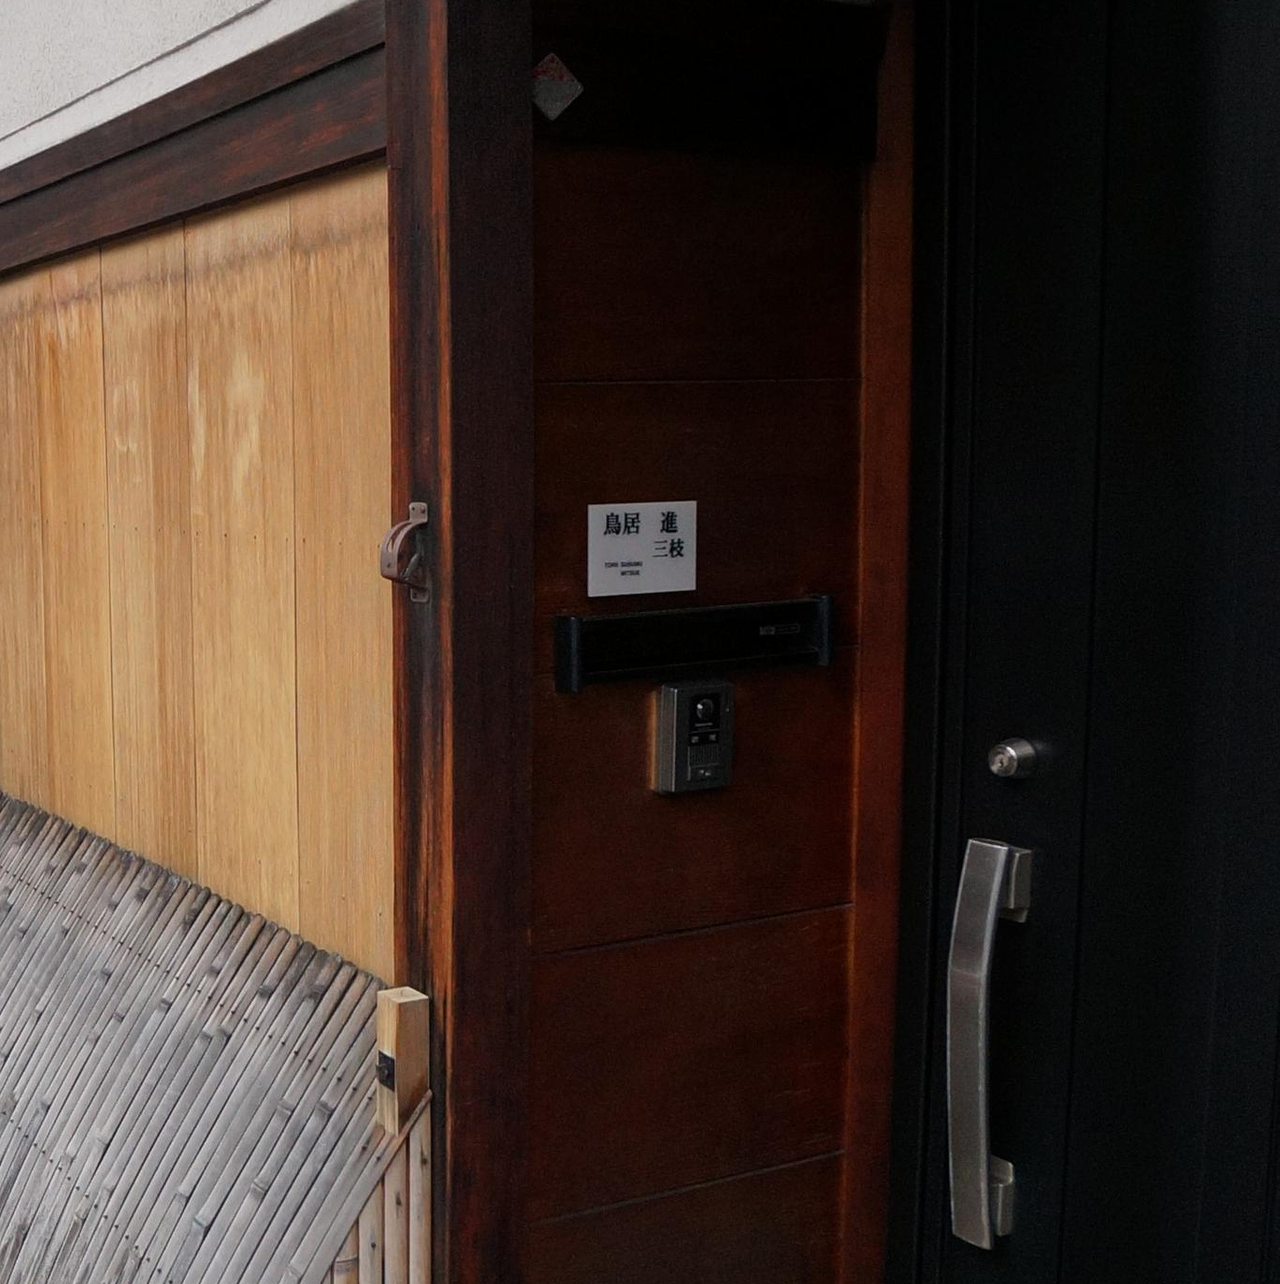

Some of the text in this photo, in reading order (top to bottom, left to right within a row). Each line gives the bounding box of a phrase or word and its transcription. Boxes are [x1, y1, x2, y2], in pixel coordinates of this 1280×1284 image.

[604, 511, 678, 535] 鳥居 進
[652, 538, 685, 558] 三枝
